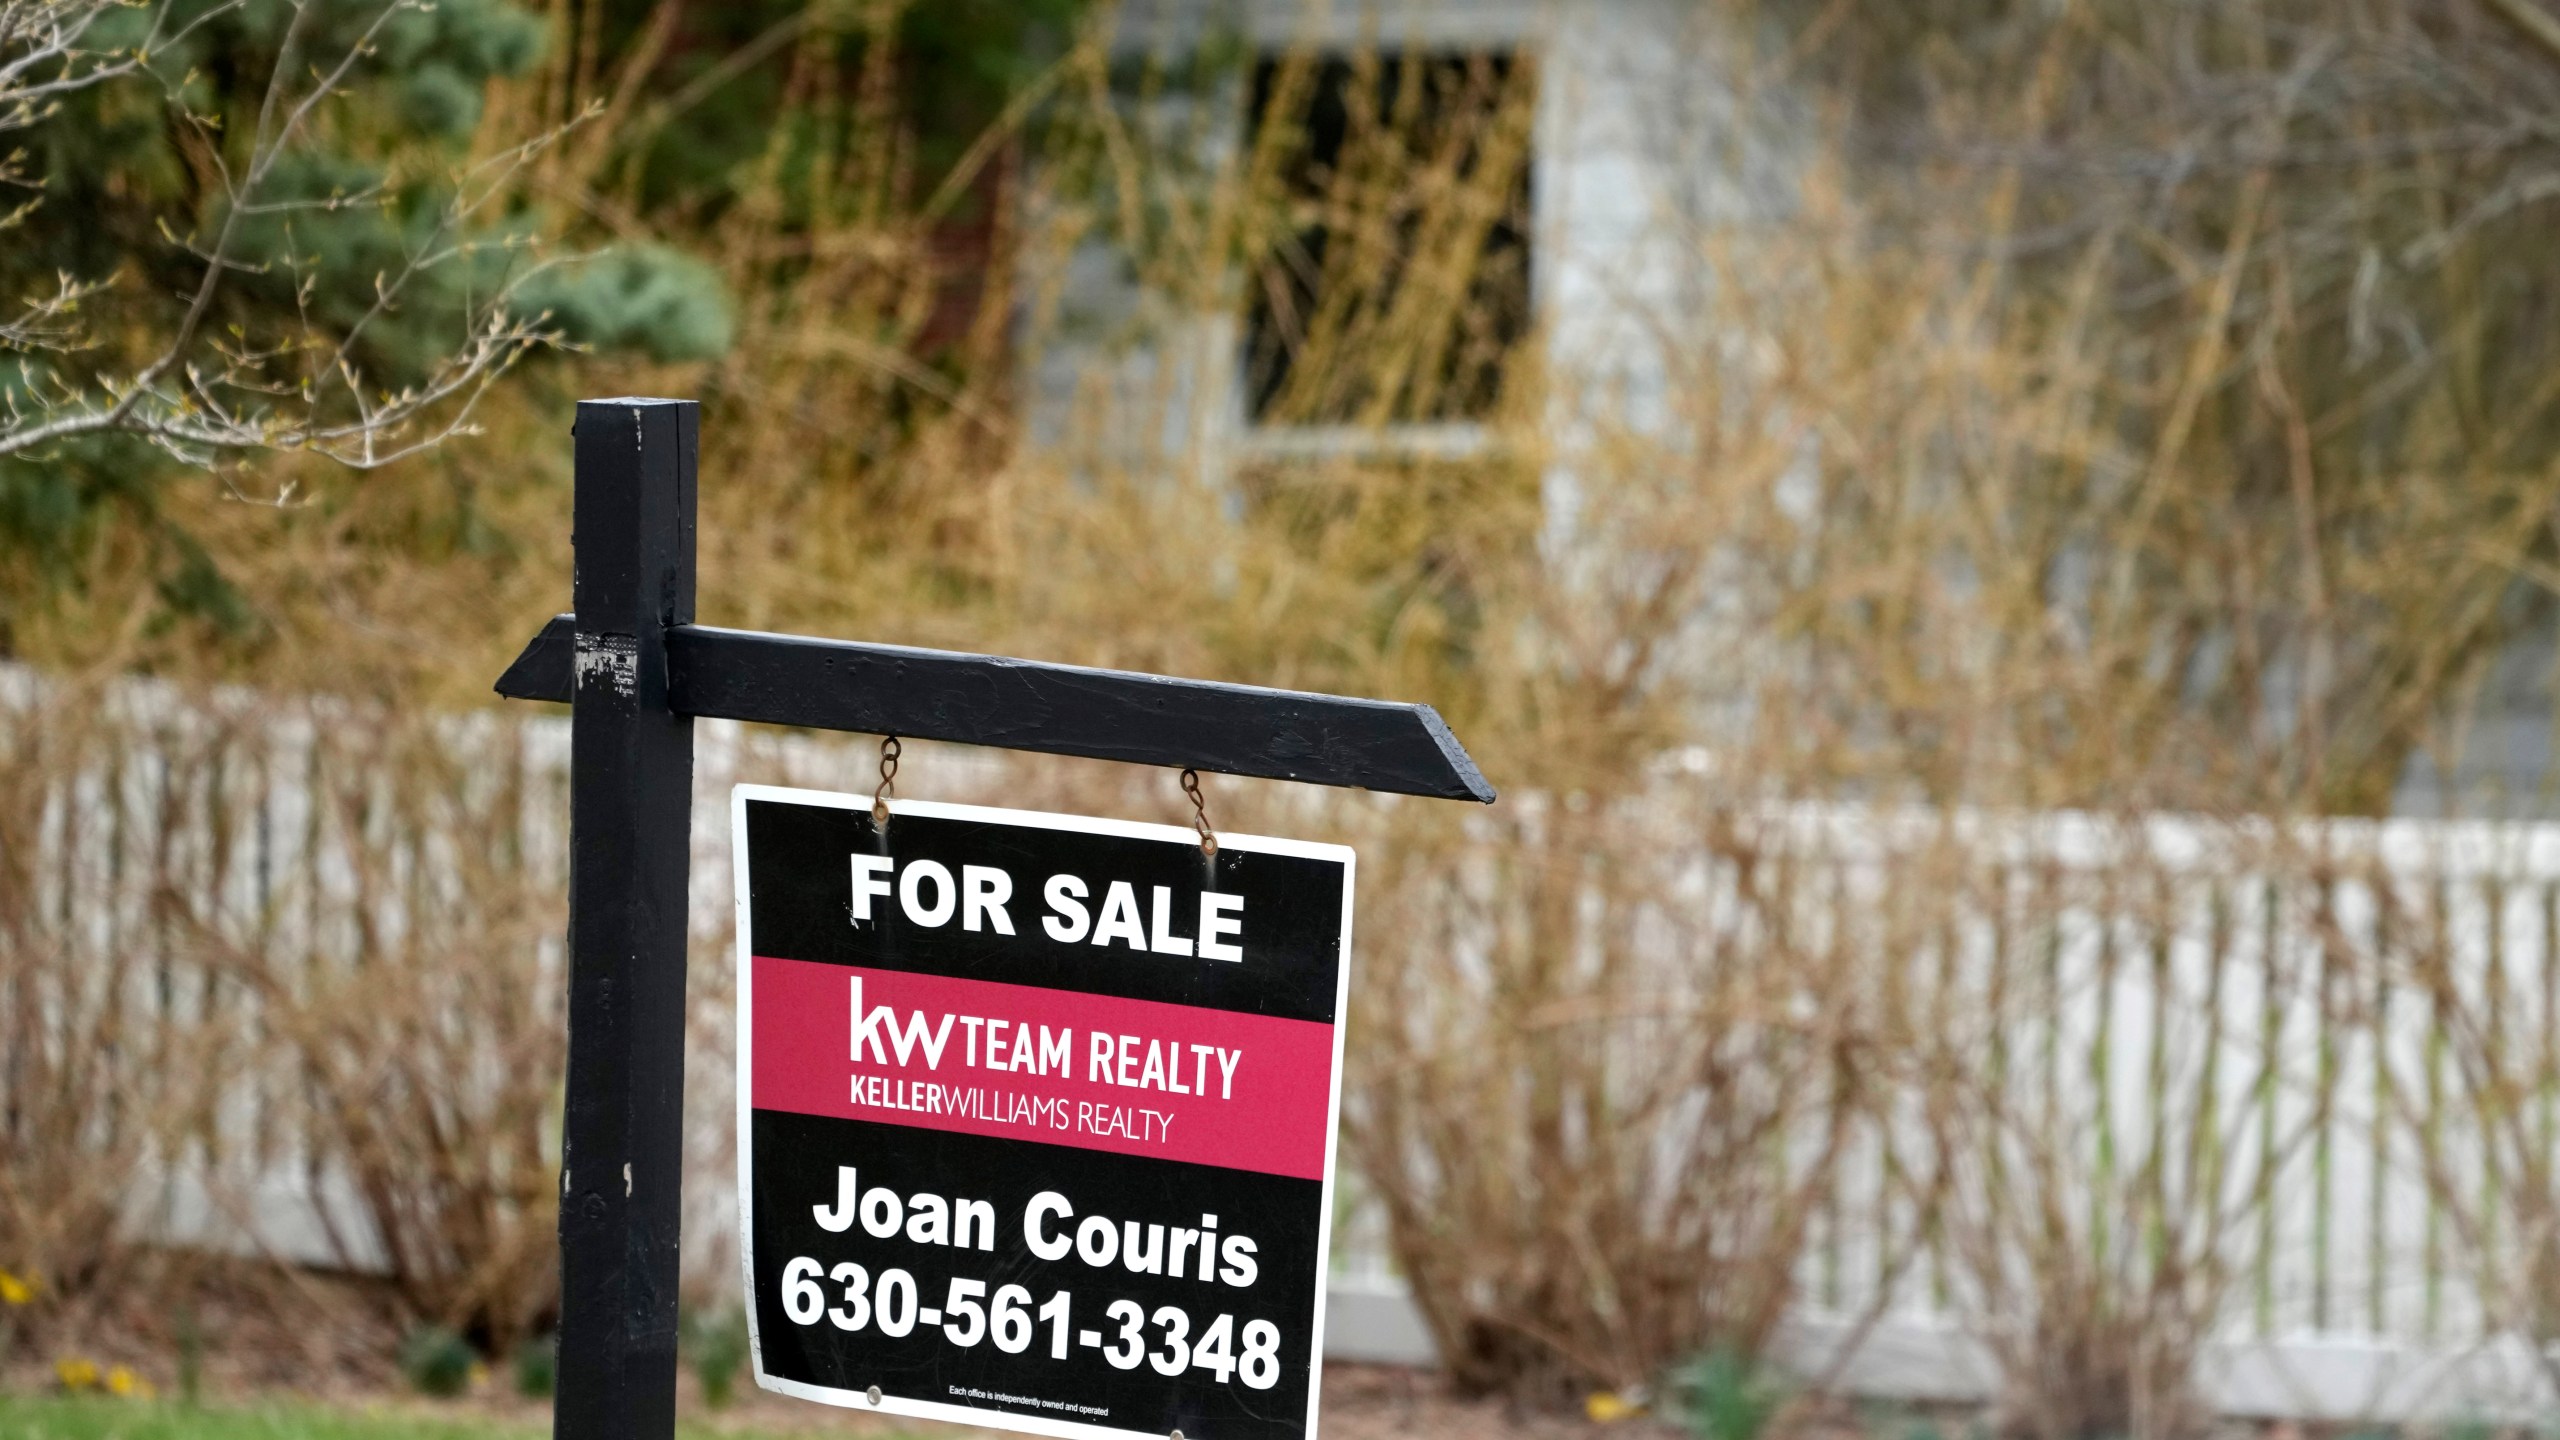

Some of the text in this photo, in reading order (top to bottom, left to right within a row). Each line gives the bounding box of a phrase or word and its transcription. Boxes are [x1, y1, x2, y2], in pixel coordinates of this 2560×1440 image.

[851, 853, 1245, 962] FOR SALE
[960, 1016, 1072, 1078] TEAM
[1089, 1032, 1242, 1100] REALTY
[1078, 1102, 1175, 1143] REALTY
[812, 1165, 1258, 1288] Joan Couris
[781, 1256, 1281, 1390] 630-561-3348
[949, 1385, 1109, 1416] Each office is independently owned and operated
